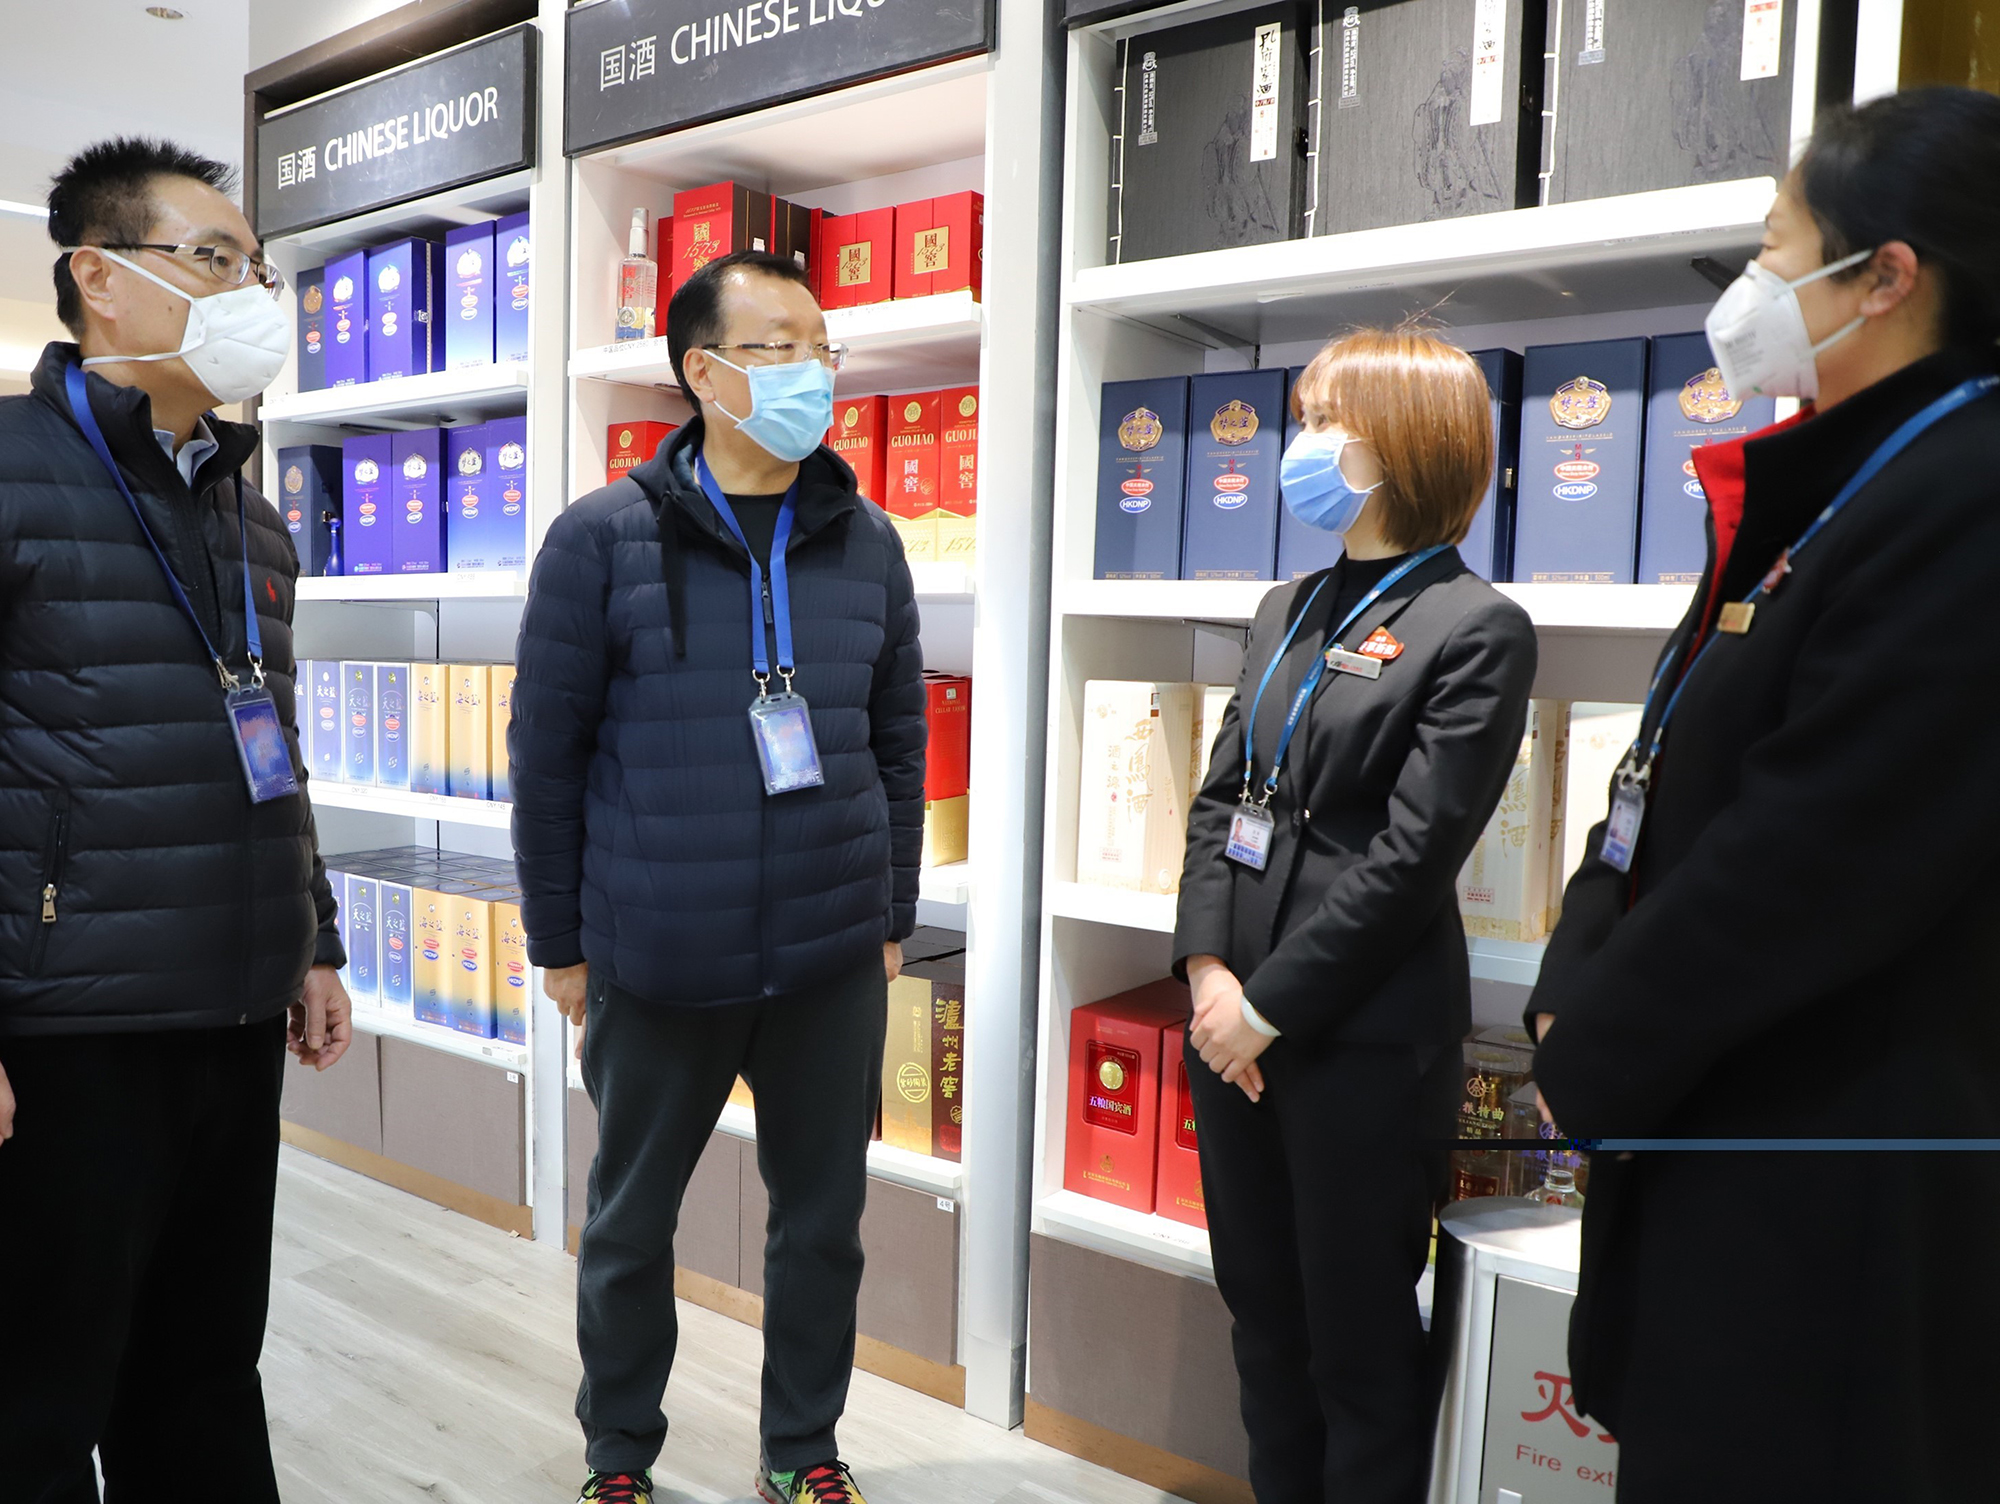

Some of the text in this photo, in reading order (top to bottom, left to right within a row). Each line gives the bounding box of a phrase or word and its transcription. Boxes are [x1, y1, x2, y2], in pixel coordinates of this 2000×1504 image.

[670, 0, 800, 65] CHINESE
[600, 35, 657, 92] 国酒
[324, 86, 498, 171] CHINESE LIQUOR
[277, 145, 317, 189] 国酒
[682, 239, 721, 260] 1573
[833, 436, 869, 452] GUOJIAO
[891, 432, 935, 448] GUOJIAO
[1216, 496, 1245, 504] HKDNP
[1557, 485, 1594, 495] HKDNP
[1122, 500, 1149, 508] HKDNP
[1459, 1101, 1504, 1120] 粮特曲
[1521, 1370, 1617, 1443] 灭
[1516, 1443, 1615, 1487] Fire ext
